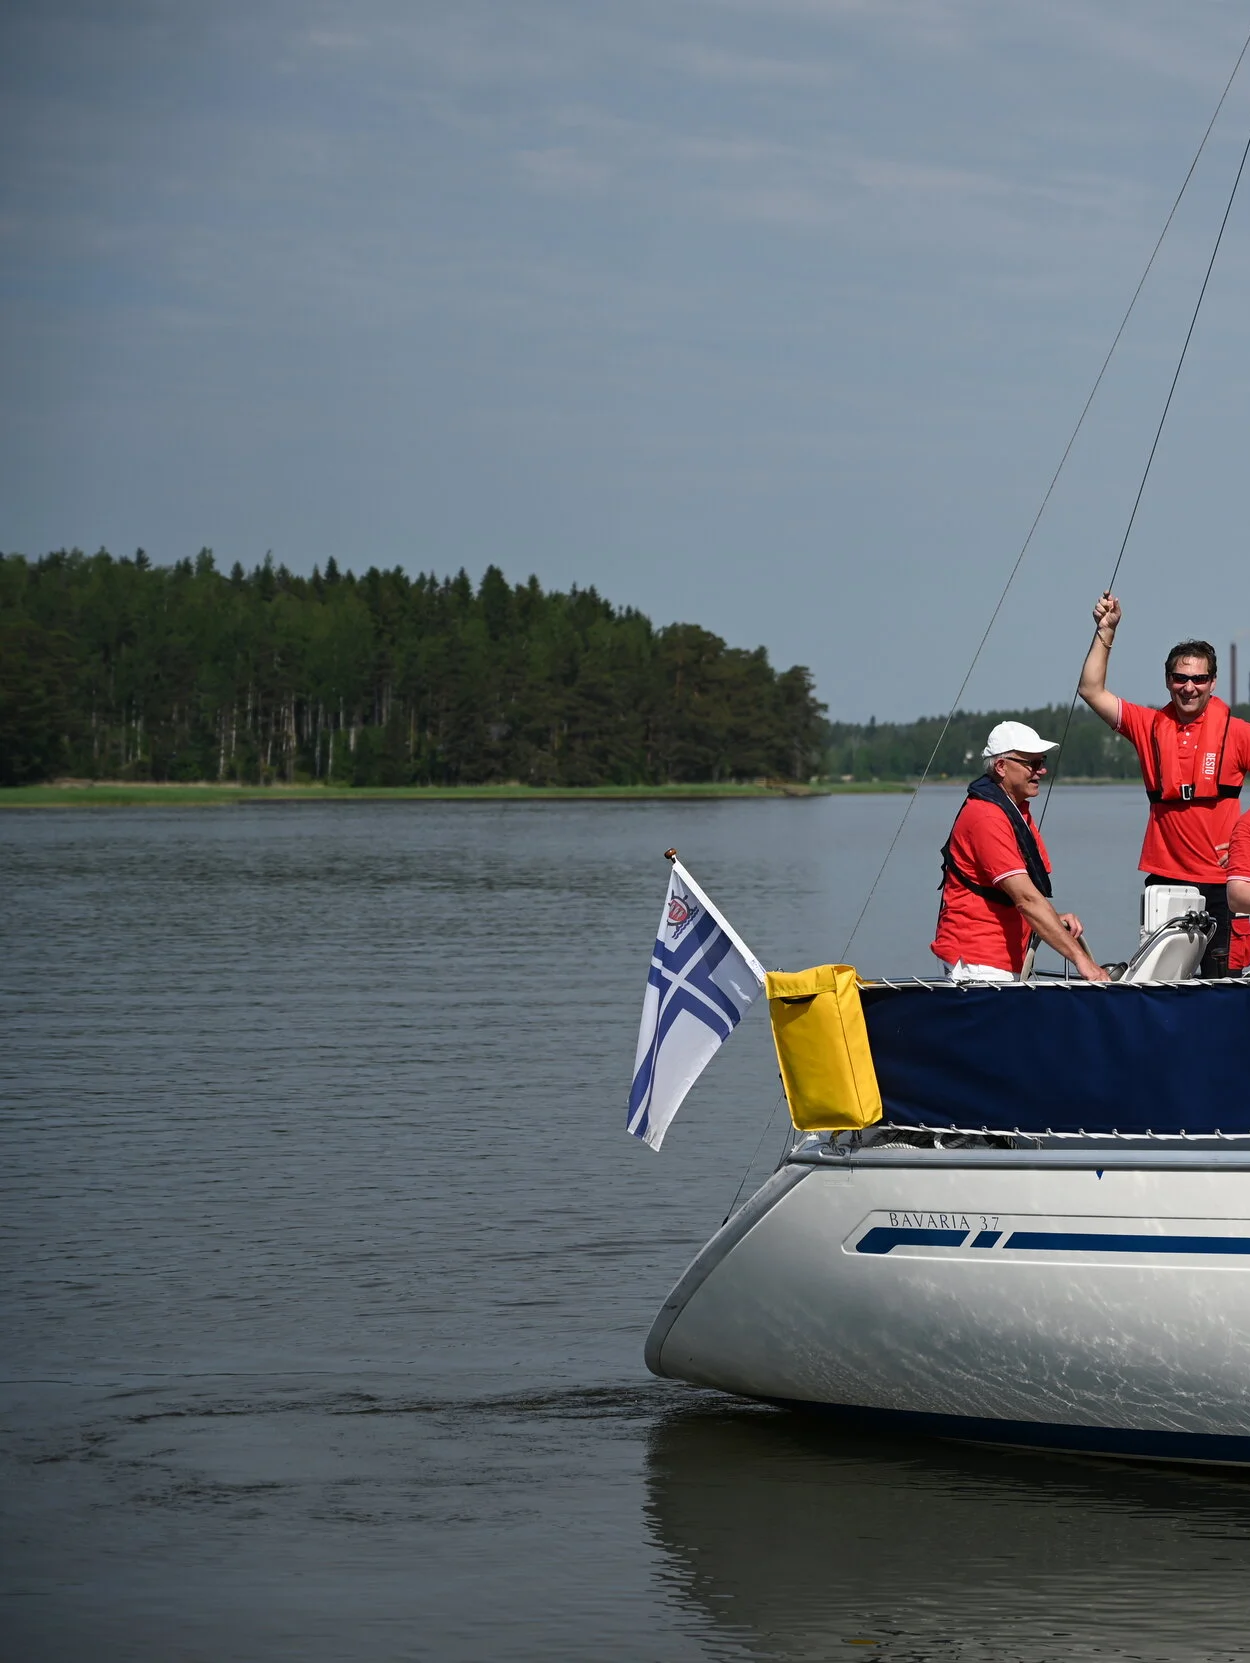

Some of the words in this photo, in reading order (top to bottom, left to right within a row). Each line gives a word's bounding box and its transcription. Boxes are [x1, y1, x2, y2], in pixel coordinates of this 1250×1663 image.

[1204, 752, 1217, 775] BESTO
[889, 1212, 971, 1230] BAVARIA
[979, 1215, 1000, 1231] 37
